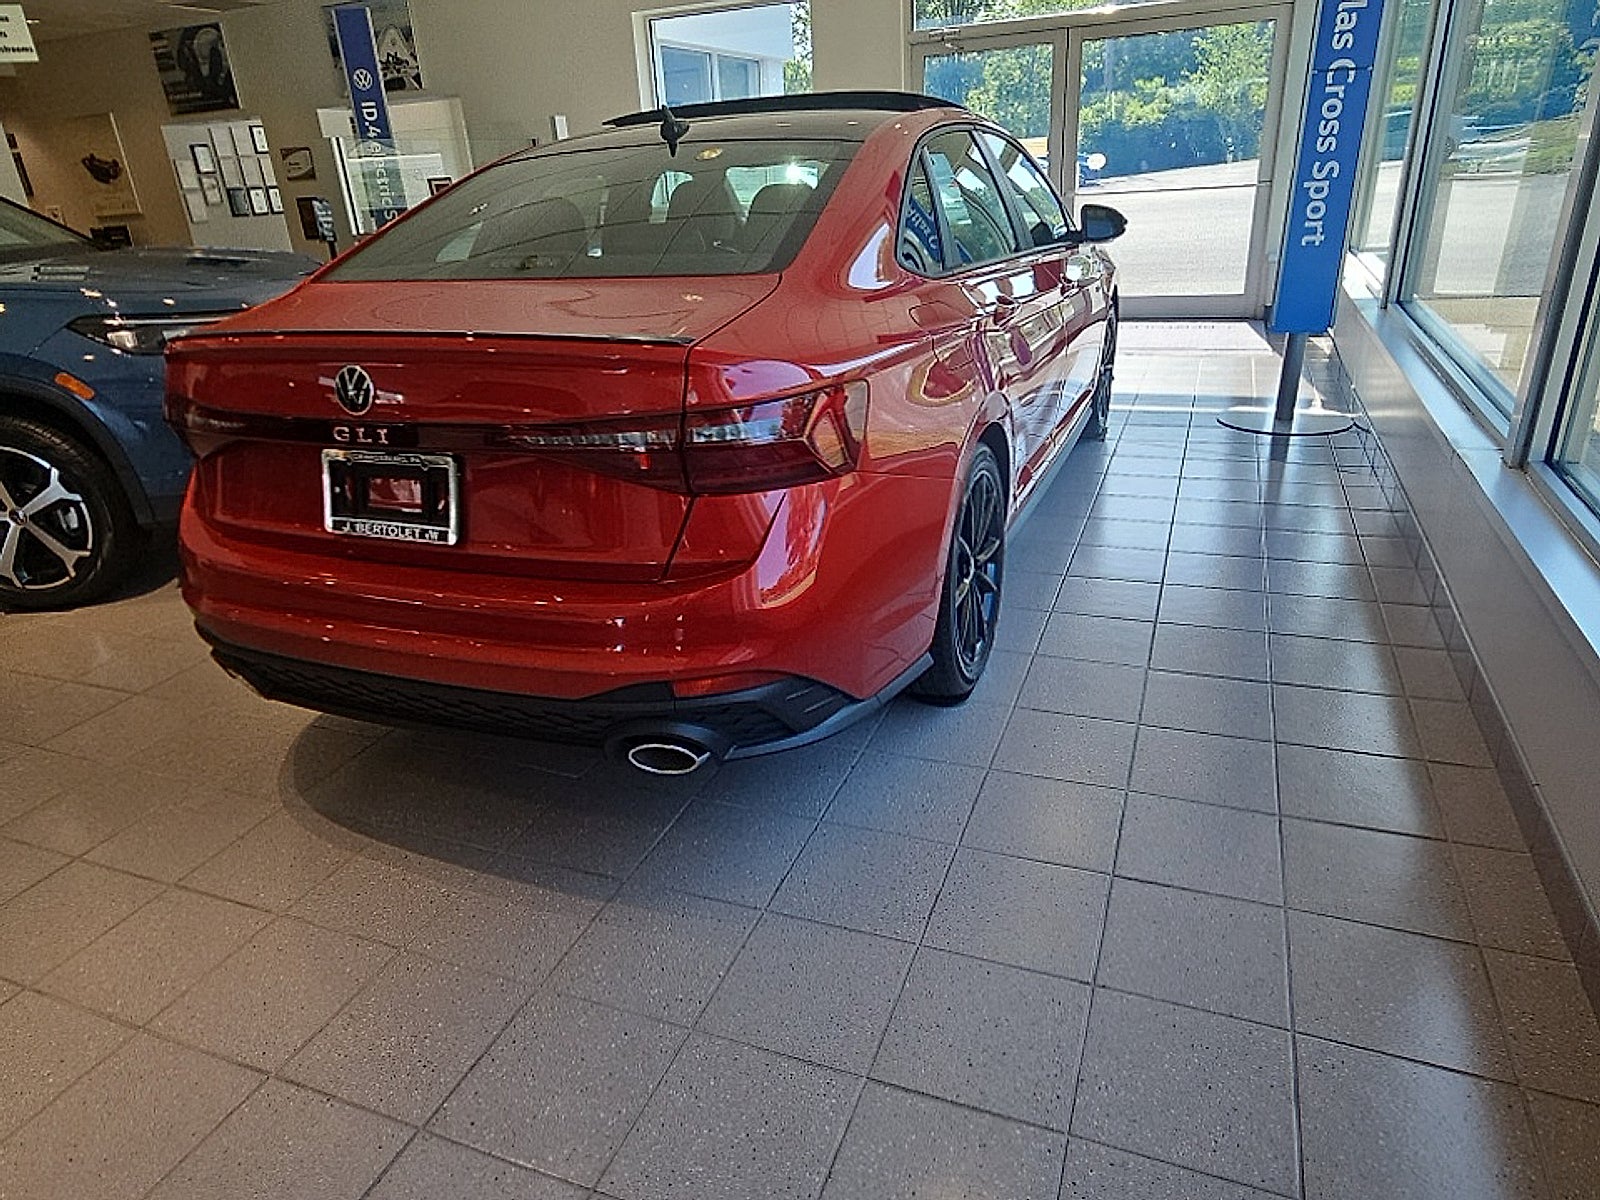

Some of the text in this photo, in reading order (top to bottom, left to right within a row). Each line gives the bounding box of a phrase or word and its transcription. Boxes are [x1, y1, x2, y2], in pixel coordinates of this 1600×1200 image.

[361, 101, 382, 138] ID.4
[1301, 0, 1367, 247] las Cross Sport
[333, 426, 389, 444] GLI
[354, 523, 420, 540] BERTOLET
